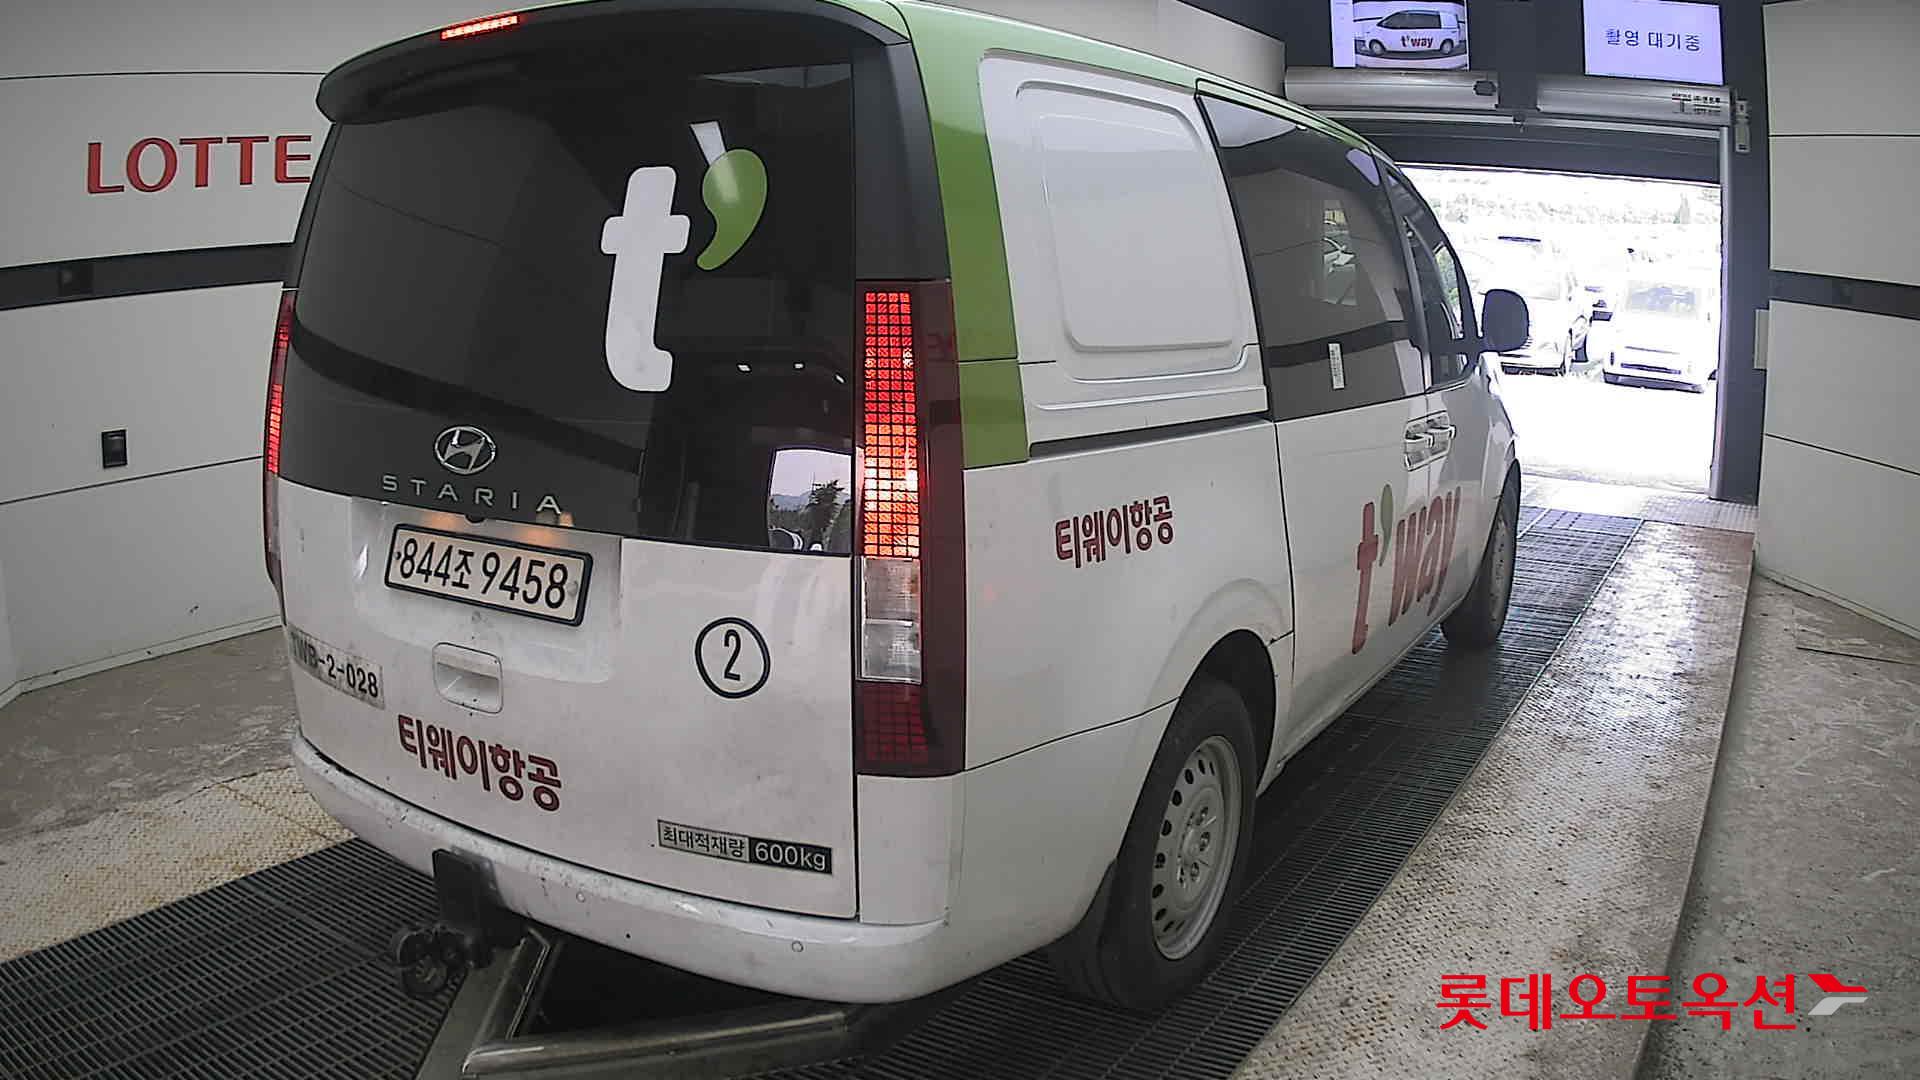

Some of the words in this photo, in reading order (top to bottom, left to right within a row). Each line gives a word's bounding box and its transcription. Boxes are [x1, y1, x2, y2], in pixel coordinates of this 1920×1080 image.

[1647, 31, 1701, 52] 대기중
[87, 134, 312, 194] LOTTE
[382, 474, 562, 515] STARIA
[1055, 495, 1175, 569] 티웨이항공
[399, 537, 475, 590] 844조
[481, 551, 569, 609] 9458
[1351, 483, 1463, 655] t'way
[397, 713, 563, 812] 티웨이항공
[663, 825, 745, 859] 최대적재량
[754, 841, 827, 872] 600kg
